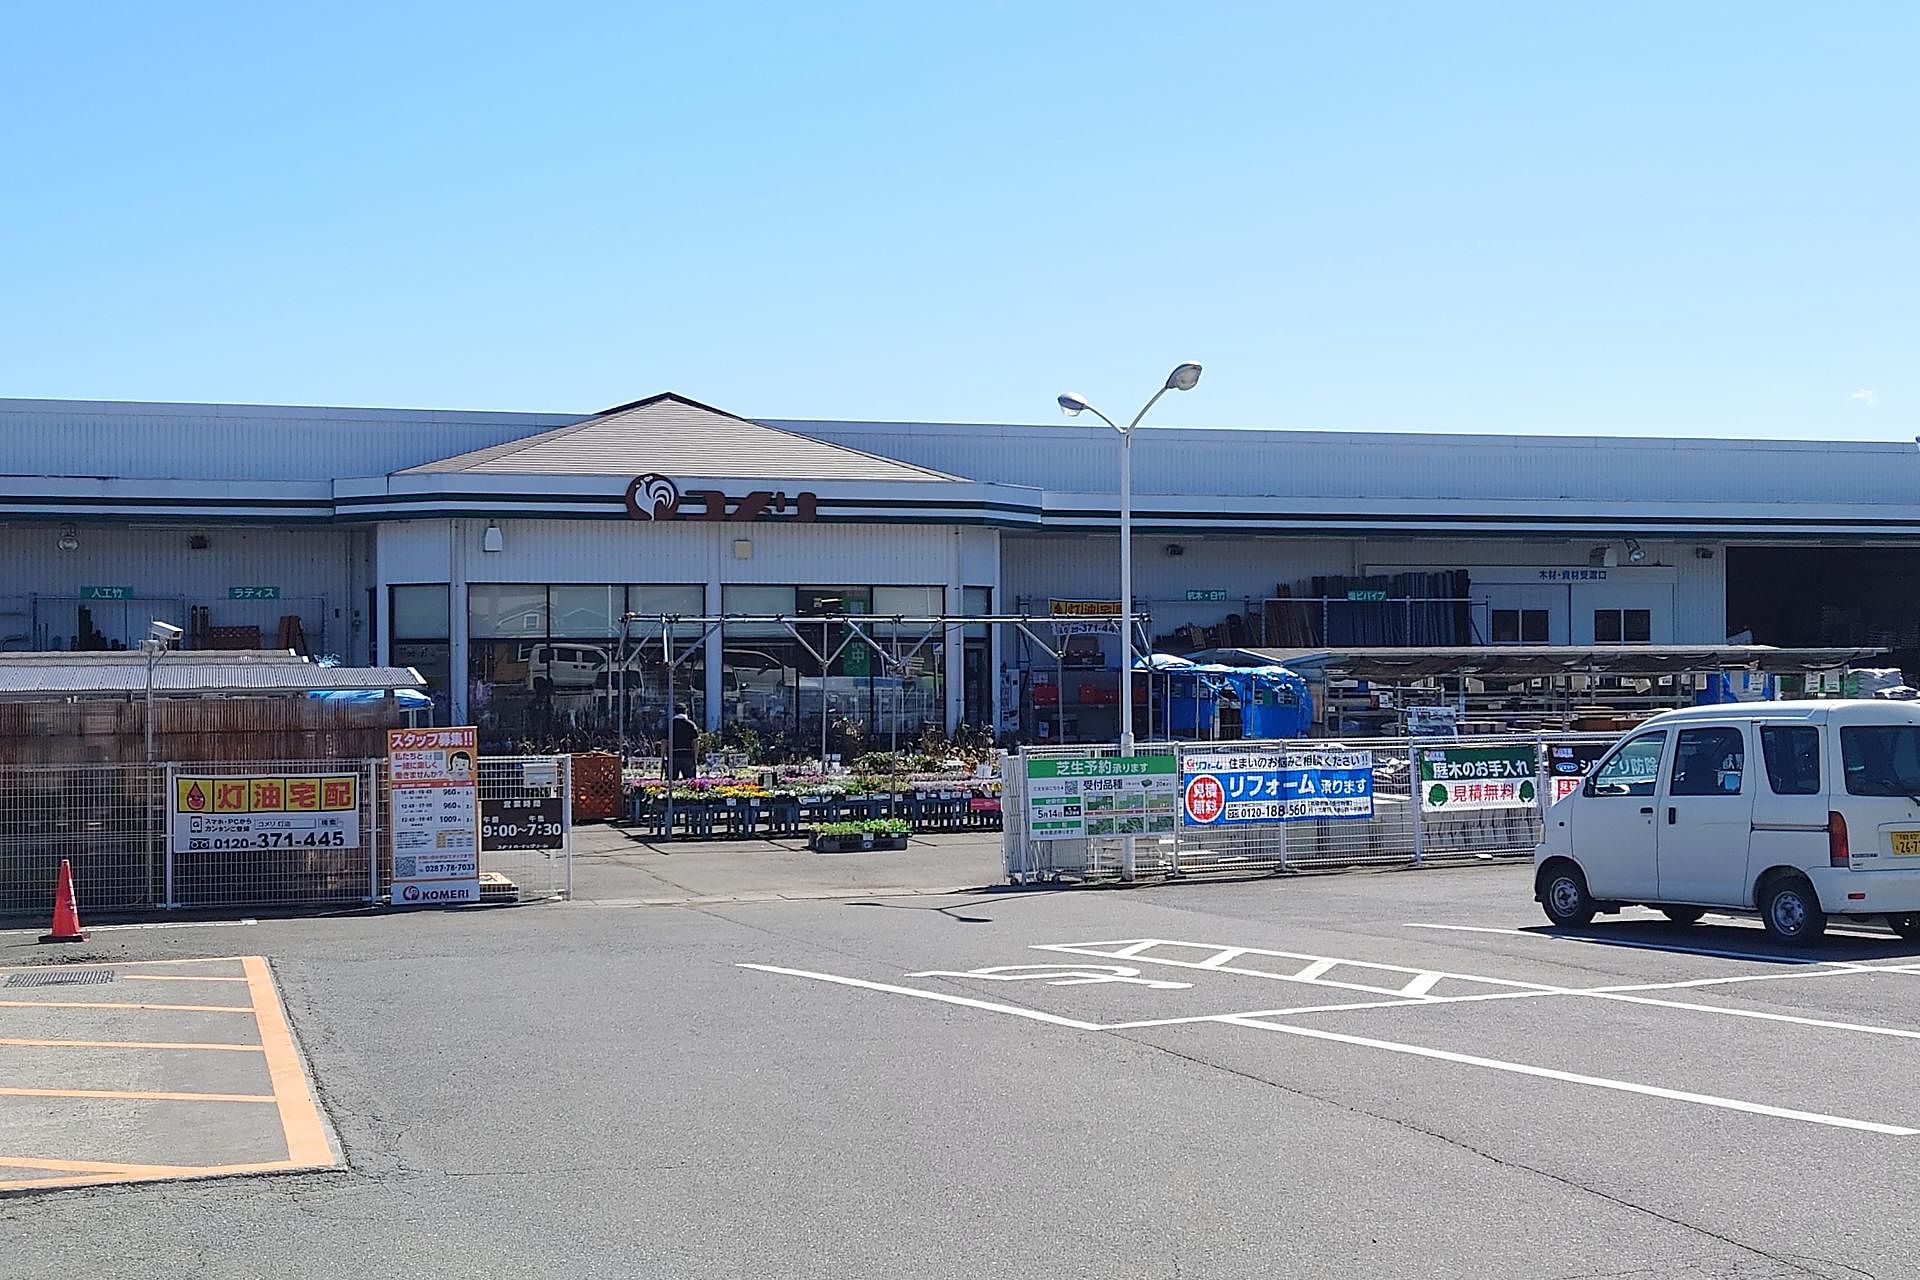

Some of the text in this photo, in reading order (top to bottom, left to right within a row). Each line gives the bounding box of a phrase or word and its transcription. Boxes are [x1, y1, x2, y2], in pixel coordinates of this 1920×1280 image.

[91, 588, 123, 598] 人工竹
[233, 588, 275, 598] ラティス
[1056, 760, 1149, 776] 芝生予約承ります
[1432, 759, 1530, 780] 庭木のお手入れ
[1229, 774, 1316, 798] リフォーム
[1320, 778, 1367, 794] 承ります
[1452, 783, 1515, 803] 見積無料
[217, 782, 352, 810] 灯油宅配
[1241, 803, 1307, 818] 0120-188-560
[483, 823, 562, 838] 9:00～7:30
[213, 831, 345, 850] 0120-371-445
[1900, 841, 1920, 853] 26-7
[422, 889, 470, 900] KOMERI
